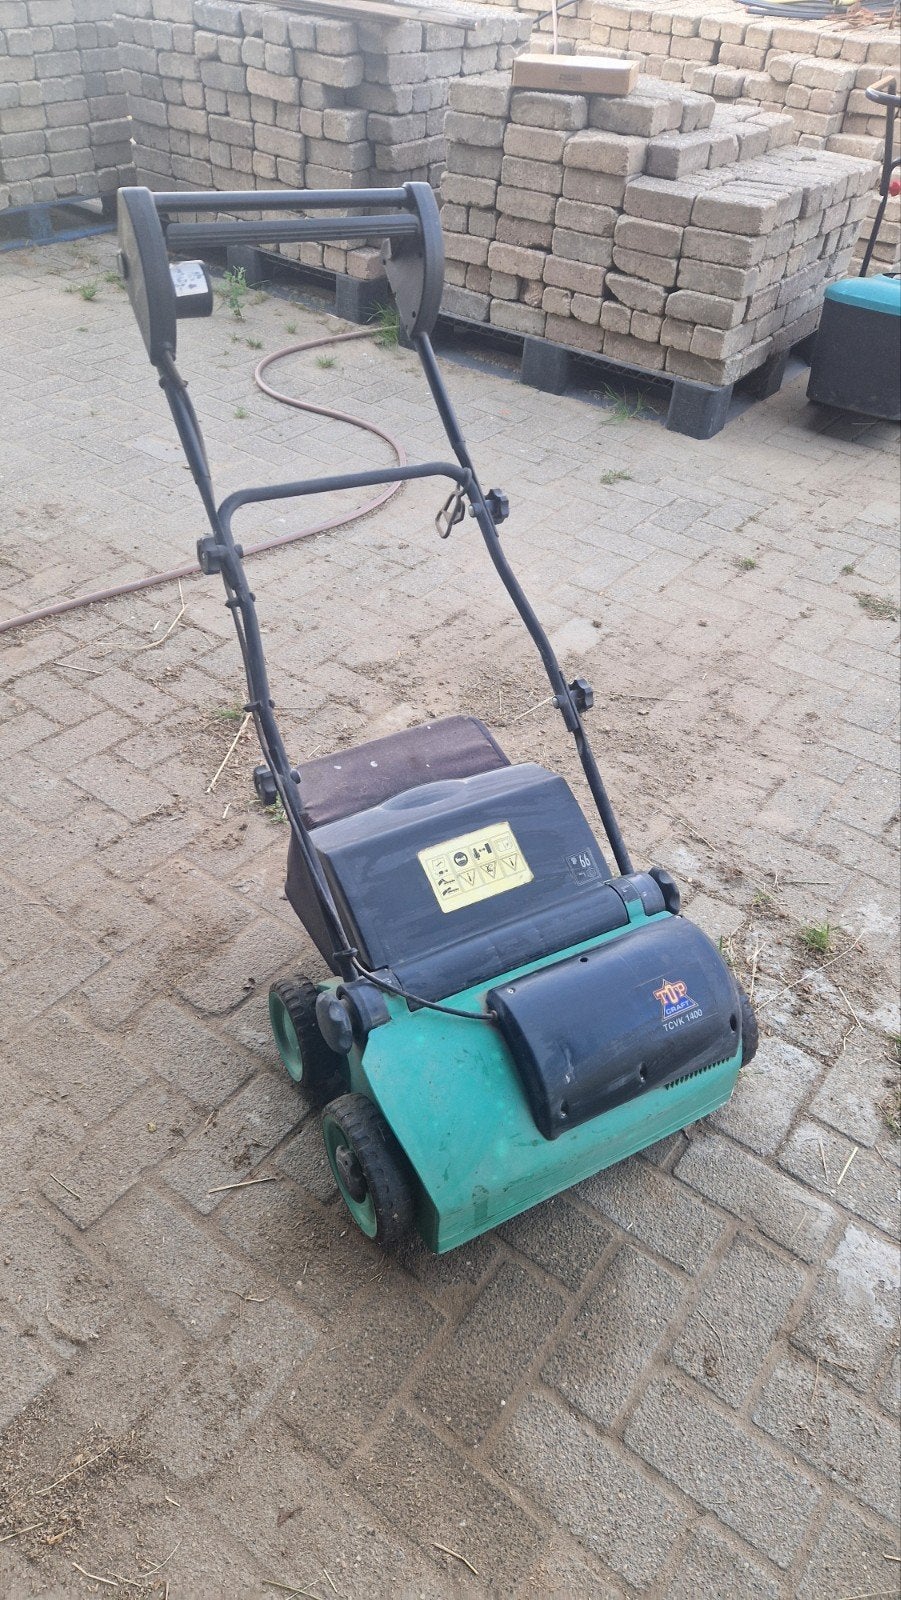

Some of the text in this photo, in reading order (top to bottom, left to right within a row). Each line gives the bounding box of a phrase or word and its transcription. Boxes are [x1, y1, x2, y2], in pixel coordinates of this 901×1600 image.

[654, 981, 687, 1004] TOP
[665, 1001, 690, 1015] CRAFT
[663, 1009, 703, 1032] TCVK 1400
